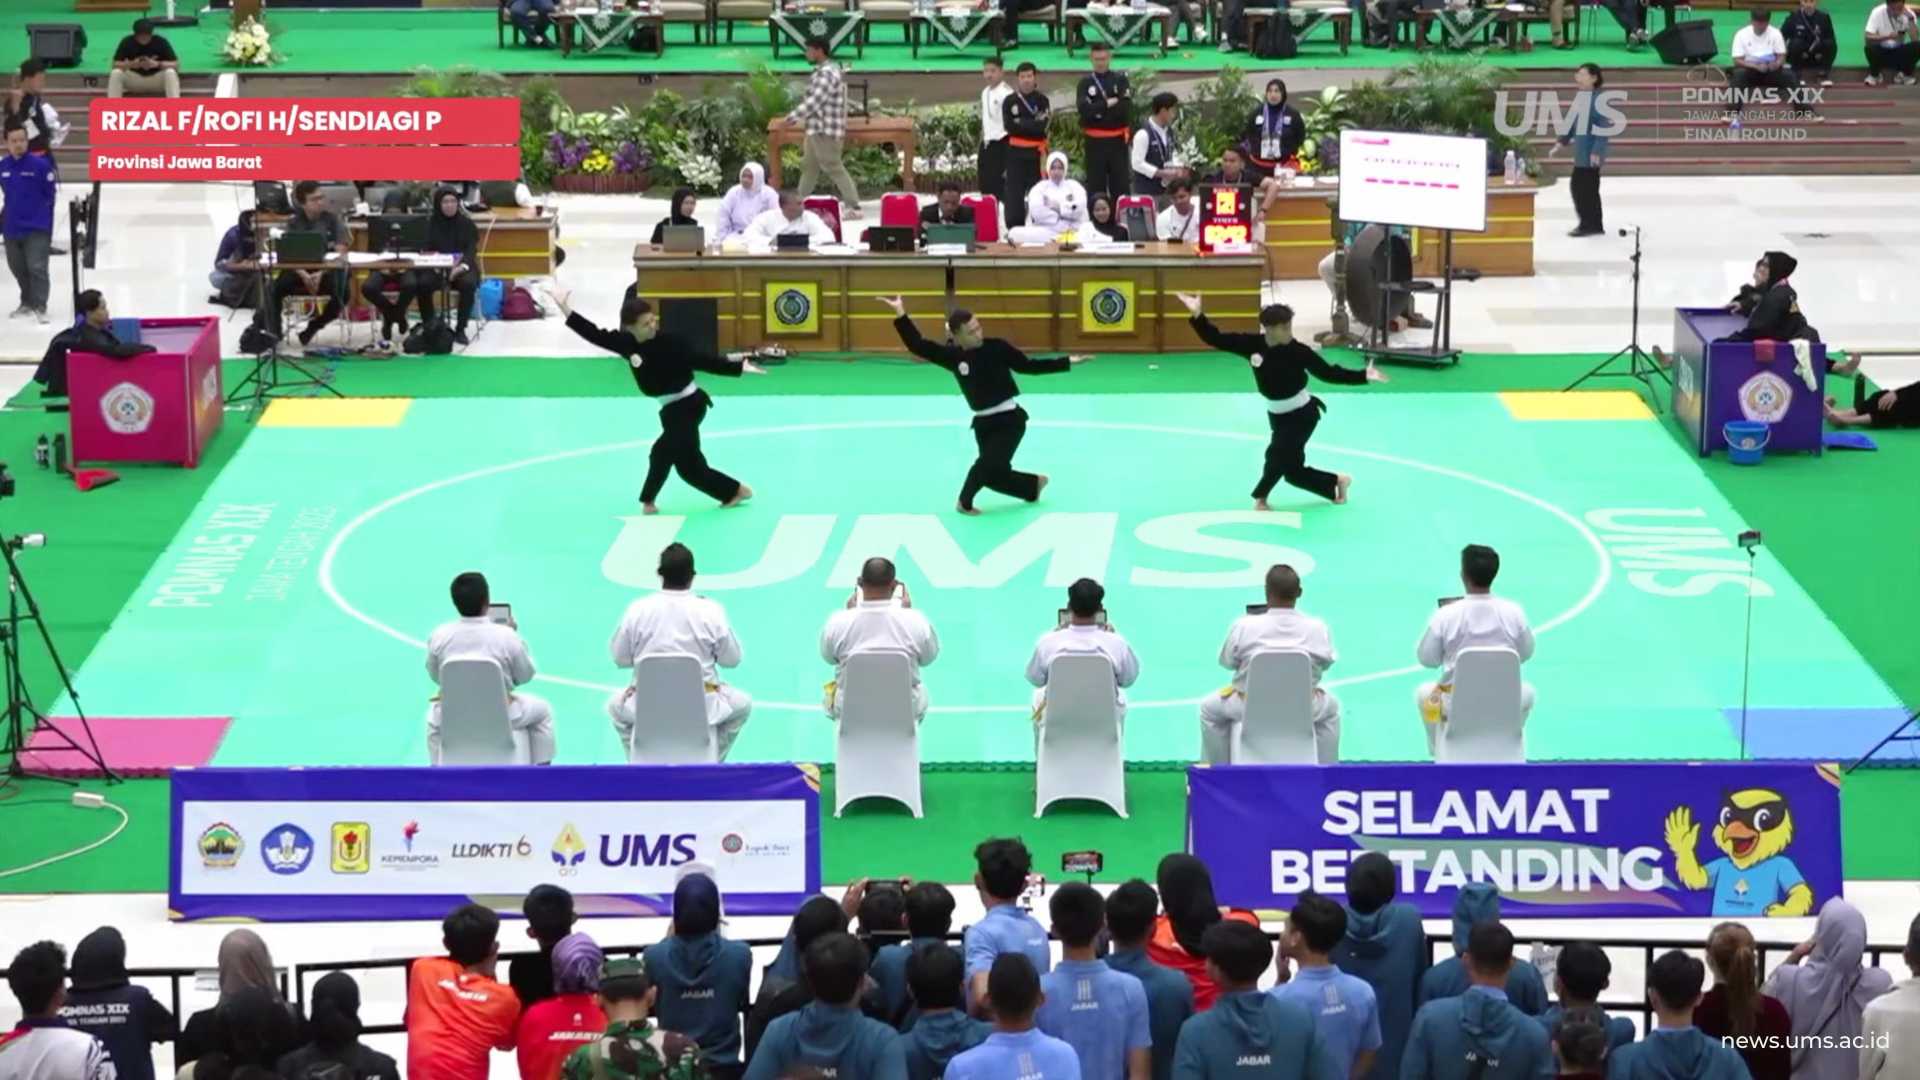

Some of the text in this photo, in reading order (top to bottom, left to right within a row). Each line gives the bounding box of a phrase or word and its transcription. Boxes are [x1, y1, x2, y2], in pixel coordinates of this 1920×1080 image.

[601, 510, 1316, 592] UMS
[1584, 506, 1776, 598] UMS
[1322, 788, 1610, 836] SELAMAT
[452, 842, 513, 859] LLDIKTI
[599, 833, 697, 867] UMS
[1270, 846, 1664, 895] BETANDING
[1236, 1055, 1271, 1066] JABAR
